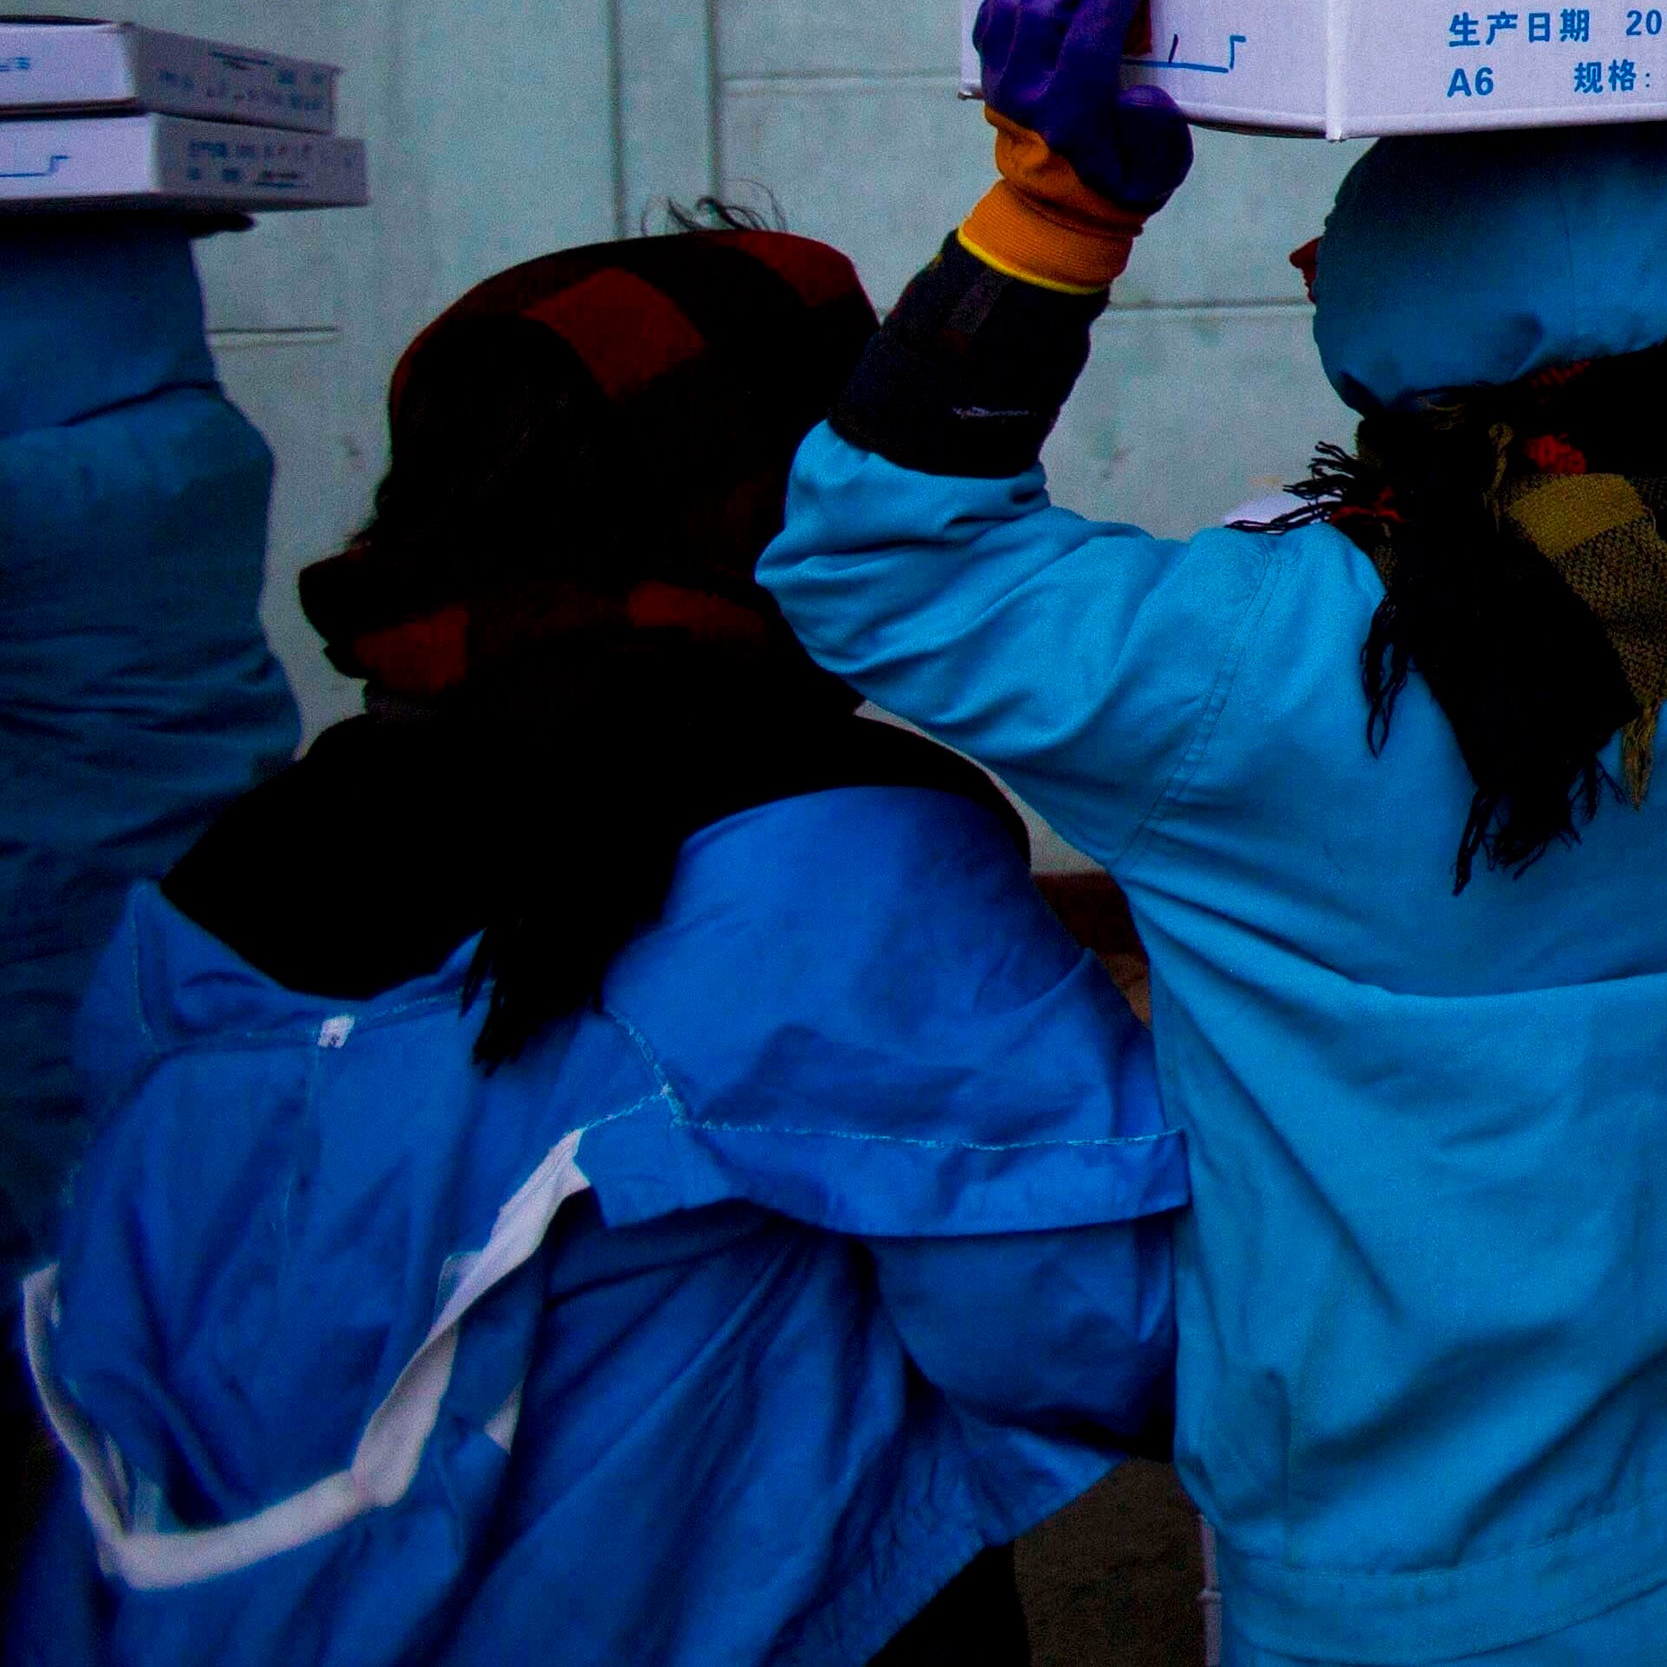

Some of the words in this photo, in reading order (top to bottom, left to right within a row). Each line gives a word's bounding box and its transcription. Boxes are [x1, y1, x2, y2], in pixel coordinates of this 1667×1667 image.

[1448, 8, 1590, 48] 生产日期
[1230, 35, 1246, 70] 厂
[1446, 66, 1494, 98] A6
